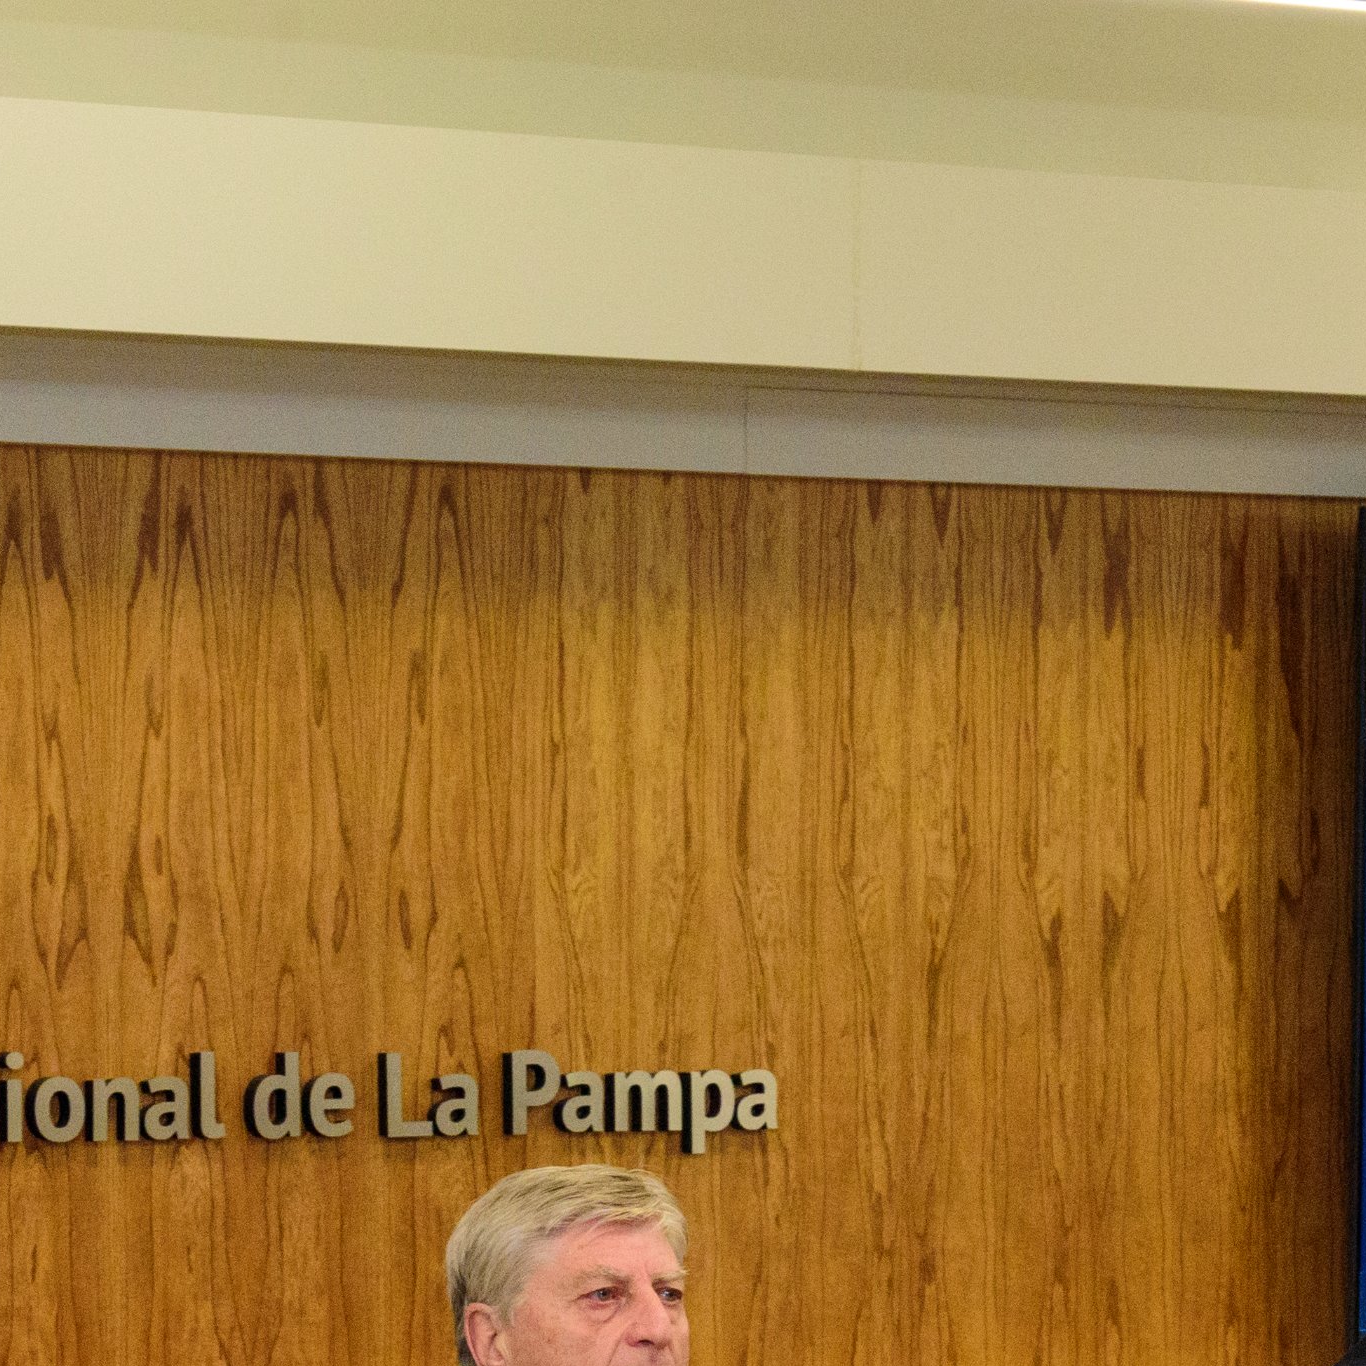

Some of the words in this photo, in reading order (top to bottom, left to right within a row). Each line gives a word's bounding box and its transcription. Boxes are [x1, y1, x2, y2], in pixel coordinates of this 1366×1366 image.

[244, 1050, 357, 1140] de
[379, 1052, 480, 1139] La
[504, 1048, 780, 1156] Pampa
